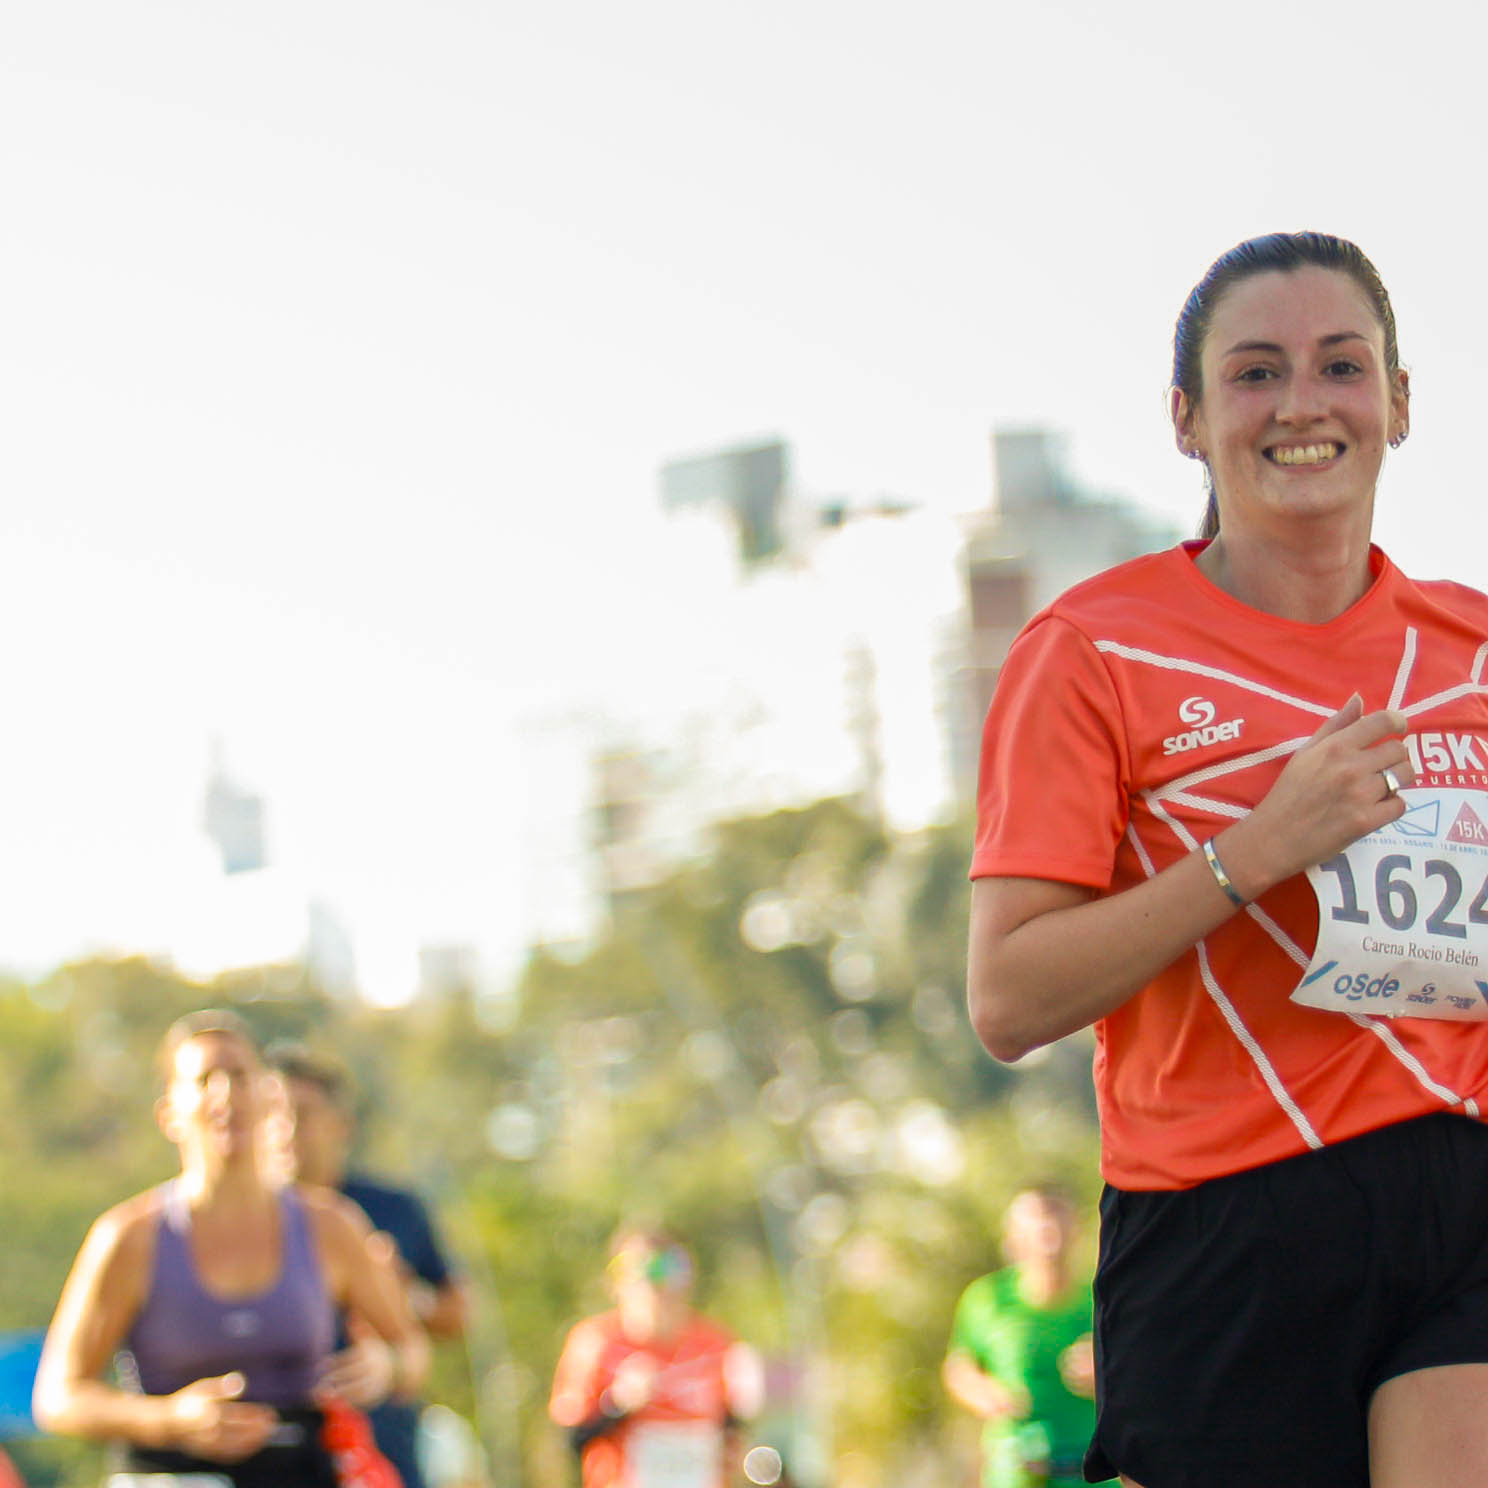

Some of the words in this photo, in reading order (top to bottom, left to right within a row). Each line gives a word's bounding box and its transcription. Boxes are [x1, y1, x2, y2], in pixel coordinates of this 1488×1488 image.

[1402, 732, 1485, 774] 15K
[1455, 820, 1485, 840] 15K
[1362, 936, 1404, 956] Carena
[1445, 947, 1479, 967] Belén
